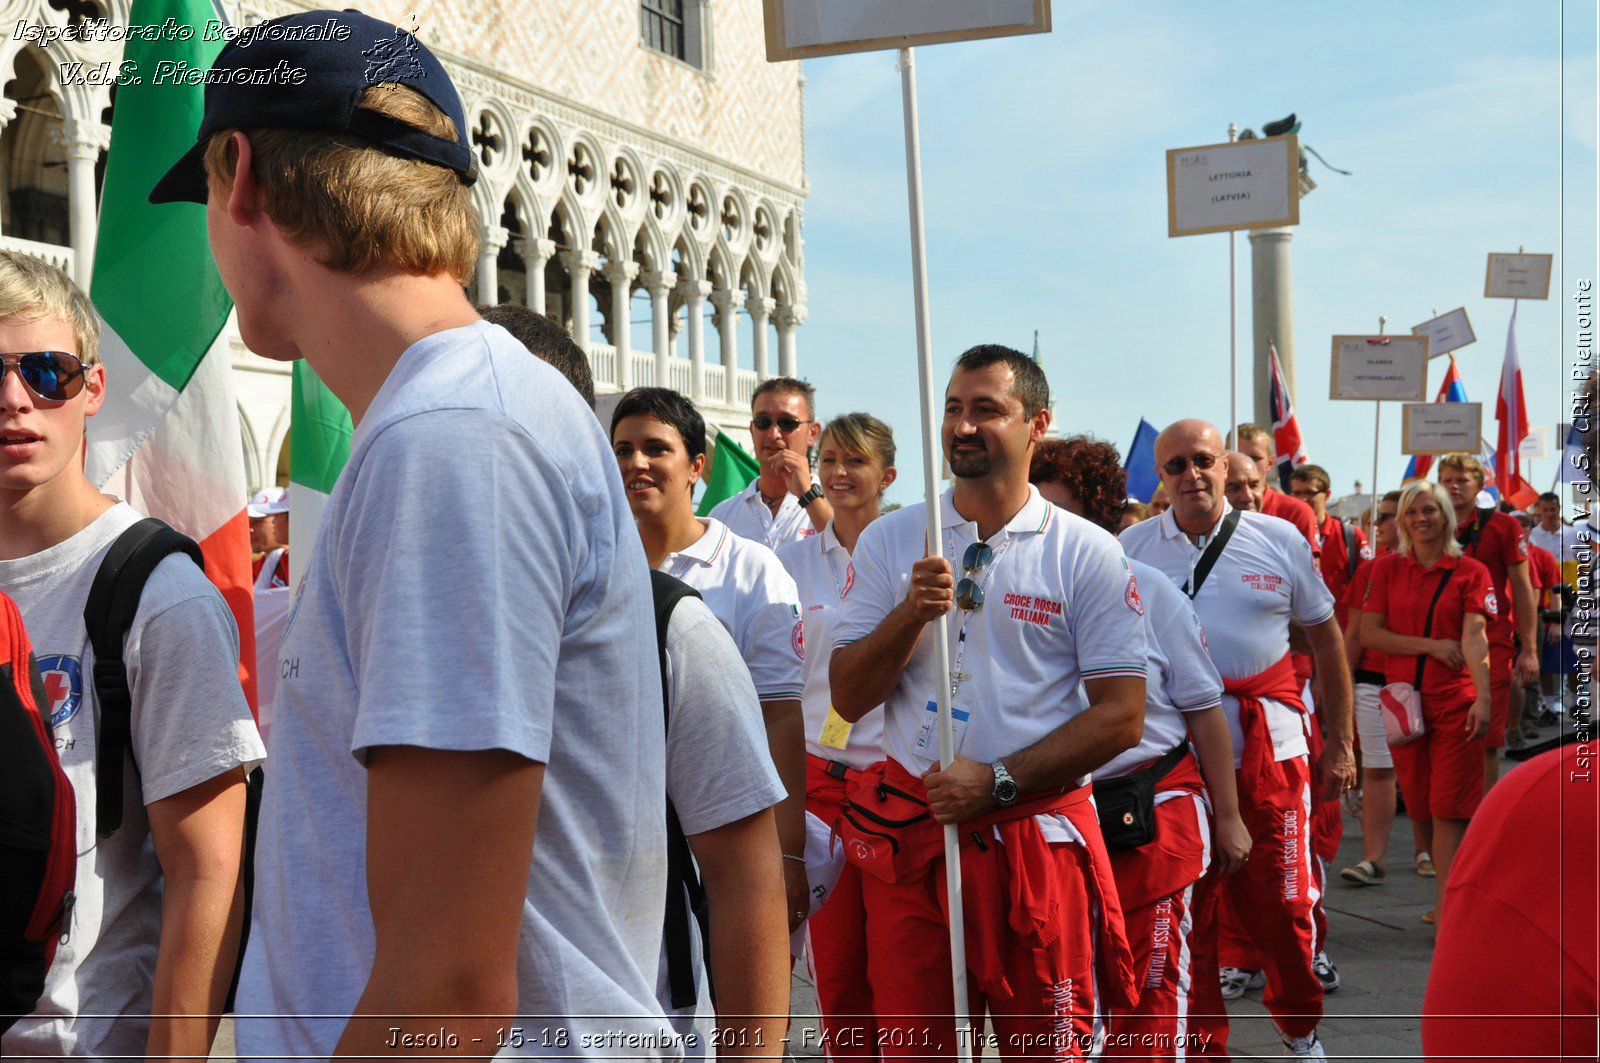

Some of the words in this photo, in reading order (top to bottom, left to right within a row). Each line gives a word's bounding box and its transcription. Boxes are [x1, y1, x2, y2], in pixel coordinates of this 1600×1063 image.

[1208, 170, 1252, 182] LETTONIA
[1211, 191, 1251, 204] (LATVIA)
[1242, 574, 1262, 583] CROCE
[1003, 593, 1031, 608] CROCE
[1034, 597, 1062, 615] ROSSA
[1010, 607, 1050, 626] ITALIANA
[1284, 810, 1298, 836] CROCE
[1284, 838, 1298, 865] ROSSA
[1284, 867, 1298, 900] ITALIANA
[1153, 917, 1171, 949] ROSSA
[1146, 951, 1167, 988] ITALIANA
[1053, 978, 1073, 1016] CROCE
